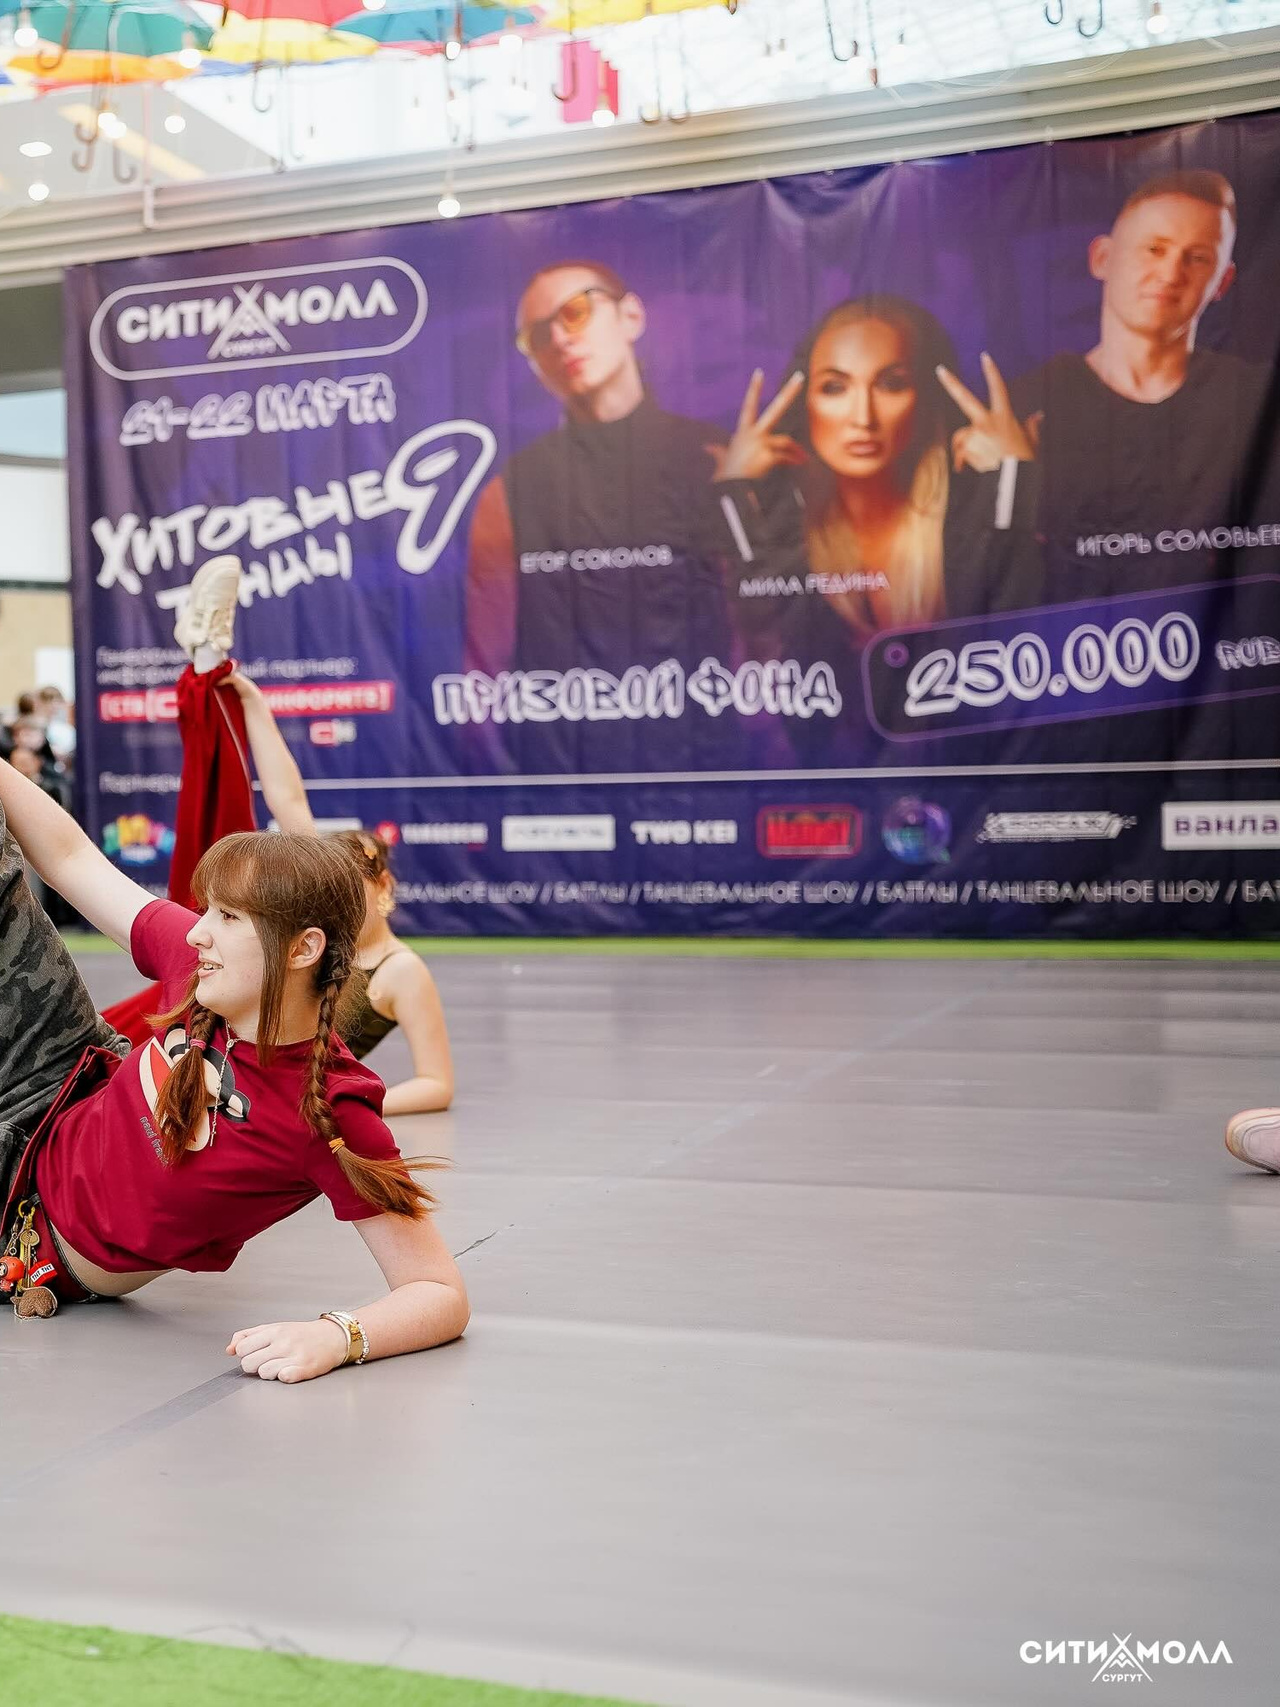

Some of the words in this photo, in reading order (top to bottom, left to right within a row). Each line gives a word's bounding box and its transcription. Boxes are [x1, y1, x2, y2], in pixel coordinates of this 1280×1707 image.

[256, 372, 397, 433] МАРТА
[520, 550, 568, 574] ЕГОР
[1075, 532, 1152, 557] ИГОРЬ
[154, 531, 353, 622] ТНЦЫ
[738, 574, 805, 598] МИЛА
[805, 570, 891, 595] РЕДИНА
[904, 611, 1201, 718] 250.000
[431, 657, 685, 726] ПРИЗОВОЙ
[686, 656, 843, 718] ФОНД
[975, 880, 1154, 903] ТАНЦЕВАЛЬНОЕ
[1158, 880, 1220, 903] ШОУ
